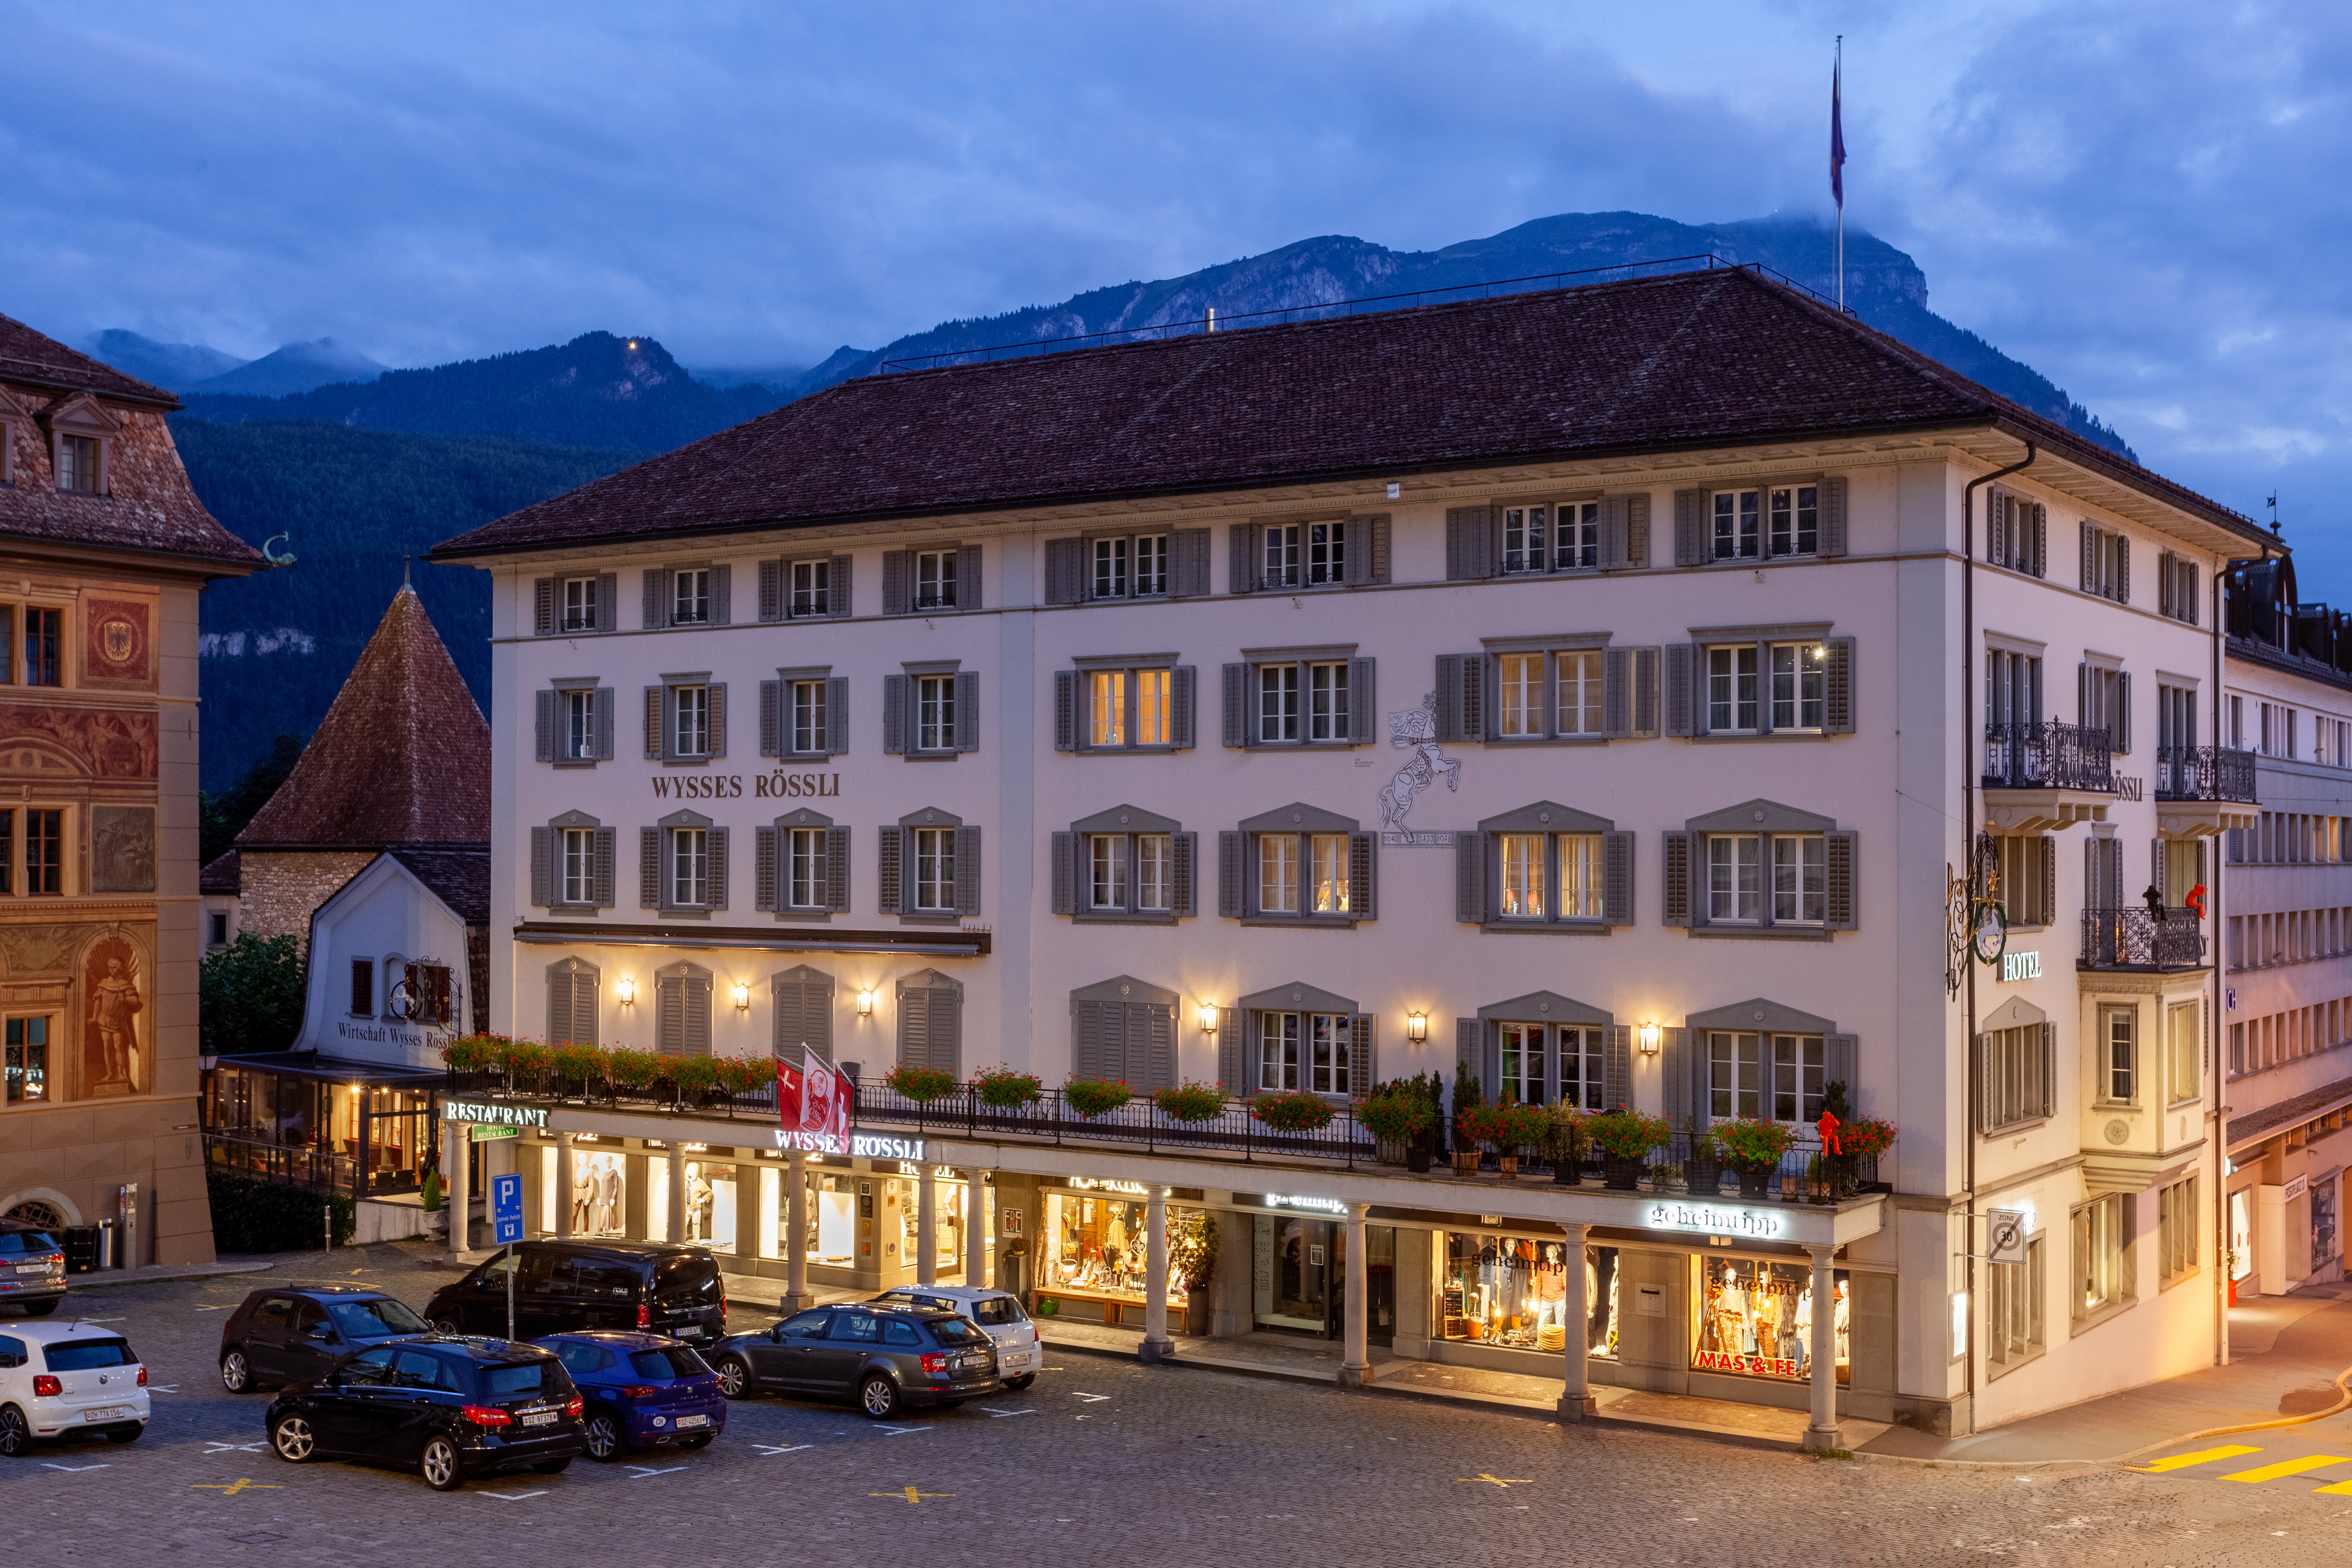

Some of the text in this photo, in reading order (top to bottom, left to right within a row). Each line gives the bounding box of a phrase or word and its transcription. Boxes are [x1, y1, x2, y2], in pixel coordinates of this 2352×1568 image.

[652, 769, 840, 798] WYSSES RÖSSLI
[2003, 951, 2041, 981] HOTEL
[338, 1022, 451, 1049] Wirtschaft Wysses Rössl
[447, 1102, 547, 1127] RESTAURANT
[477, 1129, 514, 1138] RESTAURANT
[853, 1136, 923, 1160] RÖSSLI
[501, 1180, 514, 1205] P
[1652, 1206, 1777, 1235] geheimtipp
[2002, 1231, 2012, 1241] 30
[1472, 1251, 1563, 1276] geheimtip
[1711, 1275, 1812, 1301] geheimtip
[1699, 1351, 1795, 1376] MAS & FE
